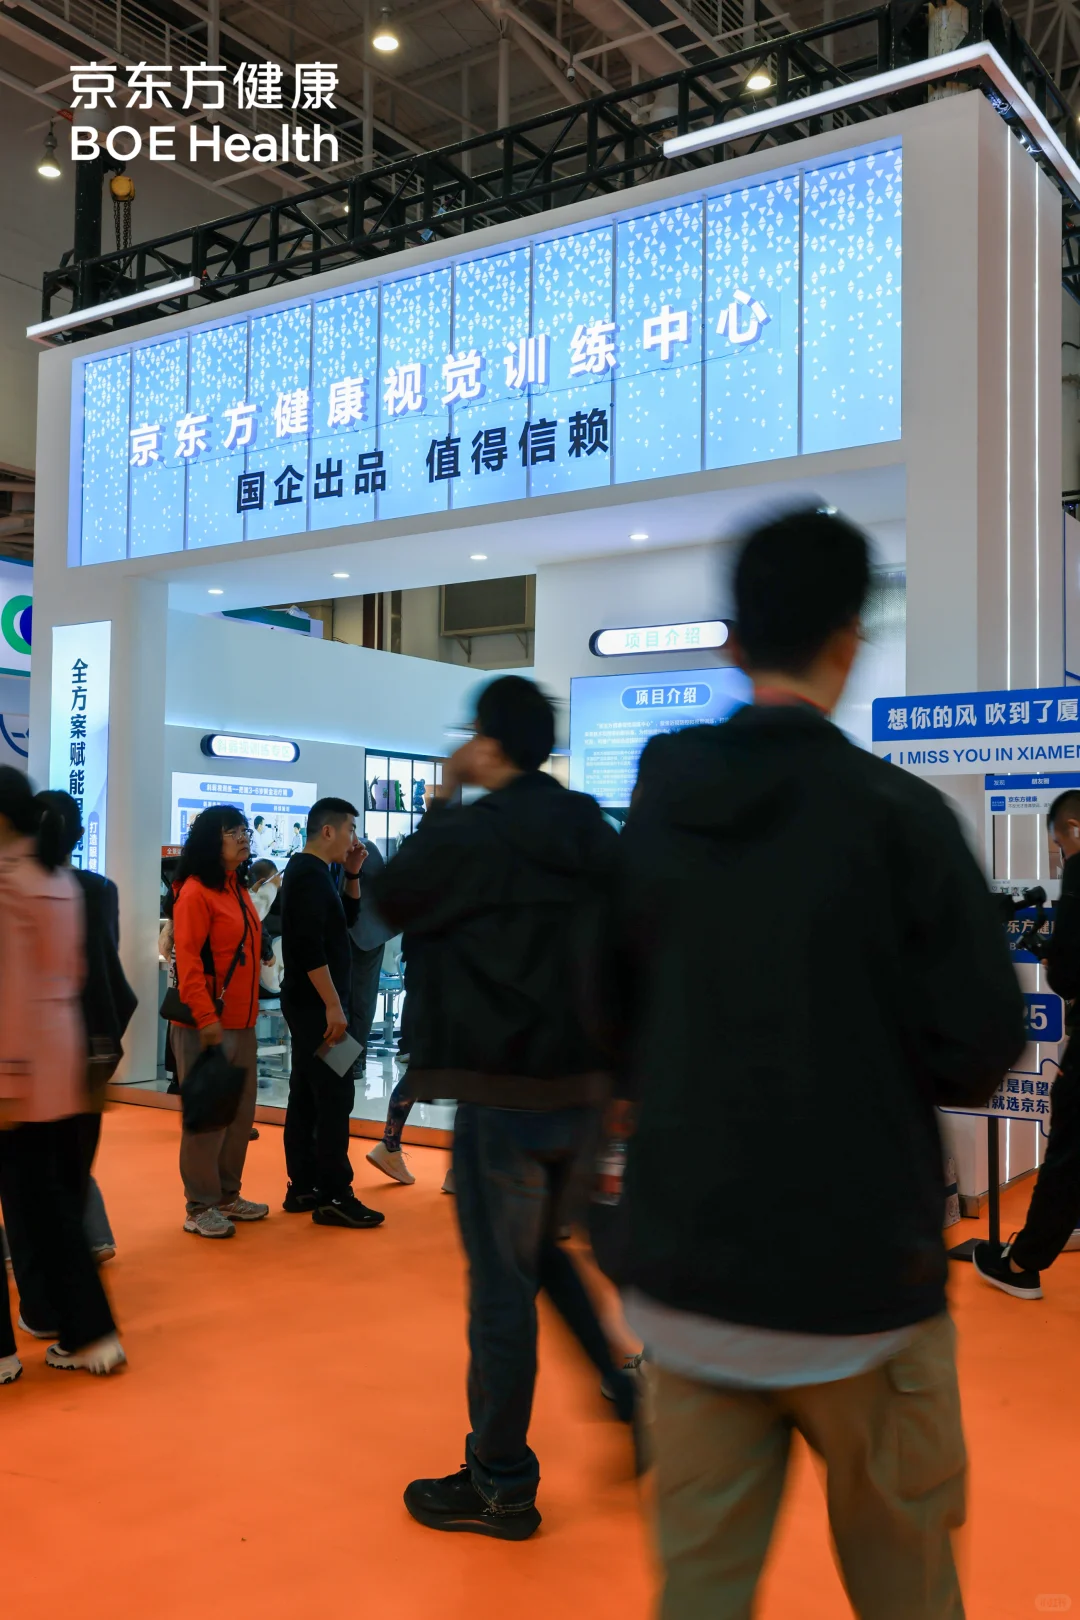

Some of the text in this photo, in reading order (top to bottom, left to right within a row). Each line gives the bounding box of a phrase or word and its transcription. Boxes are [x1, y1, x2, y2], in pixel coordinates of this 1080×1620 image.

[129, 289, 770, 468] 京东方健康视觉训练中心
[236, 407, 610, 513] 国企出品 值得信赖
[625, 627, 701, 649] 项目介绍
[635, 687, 697, 705] 项目介绍
[887, 698, 1079, 731] 想你的风 吹到了厦
[69, 658, 88, 869] 全方案赋能
[900, 752, 904, 764] I
[908, 750, 949, 764] MISS
[953, 748, 991, 763] YOU
[995, 747, 1012, 761] IN
[1007, 919, 1055, 935] 东方健
[985, 1095, 1050, 1114] 就选京东
